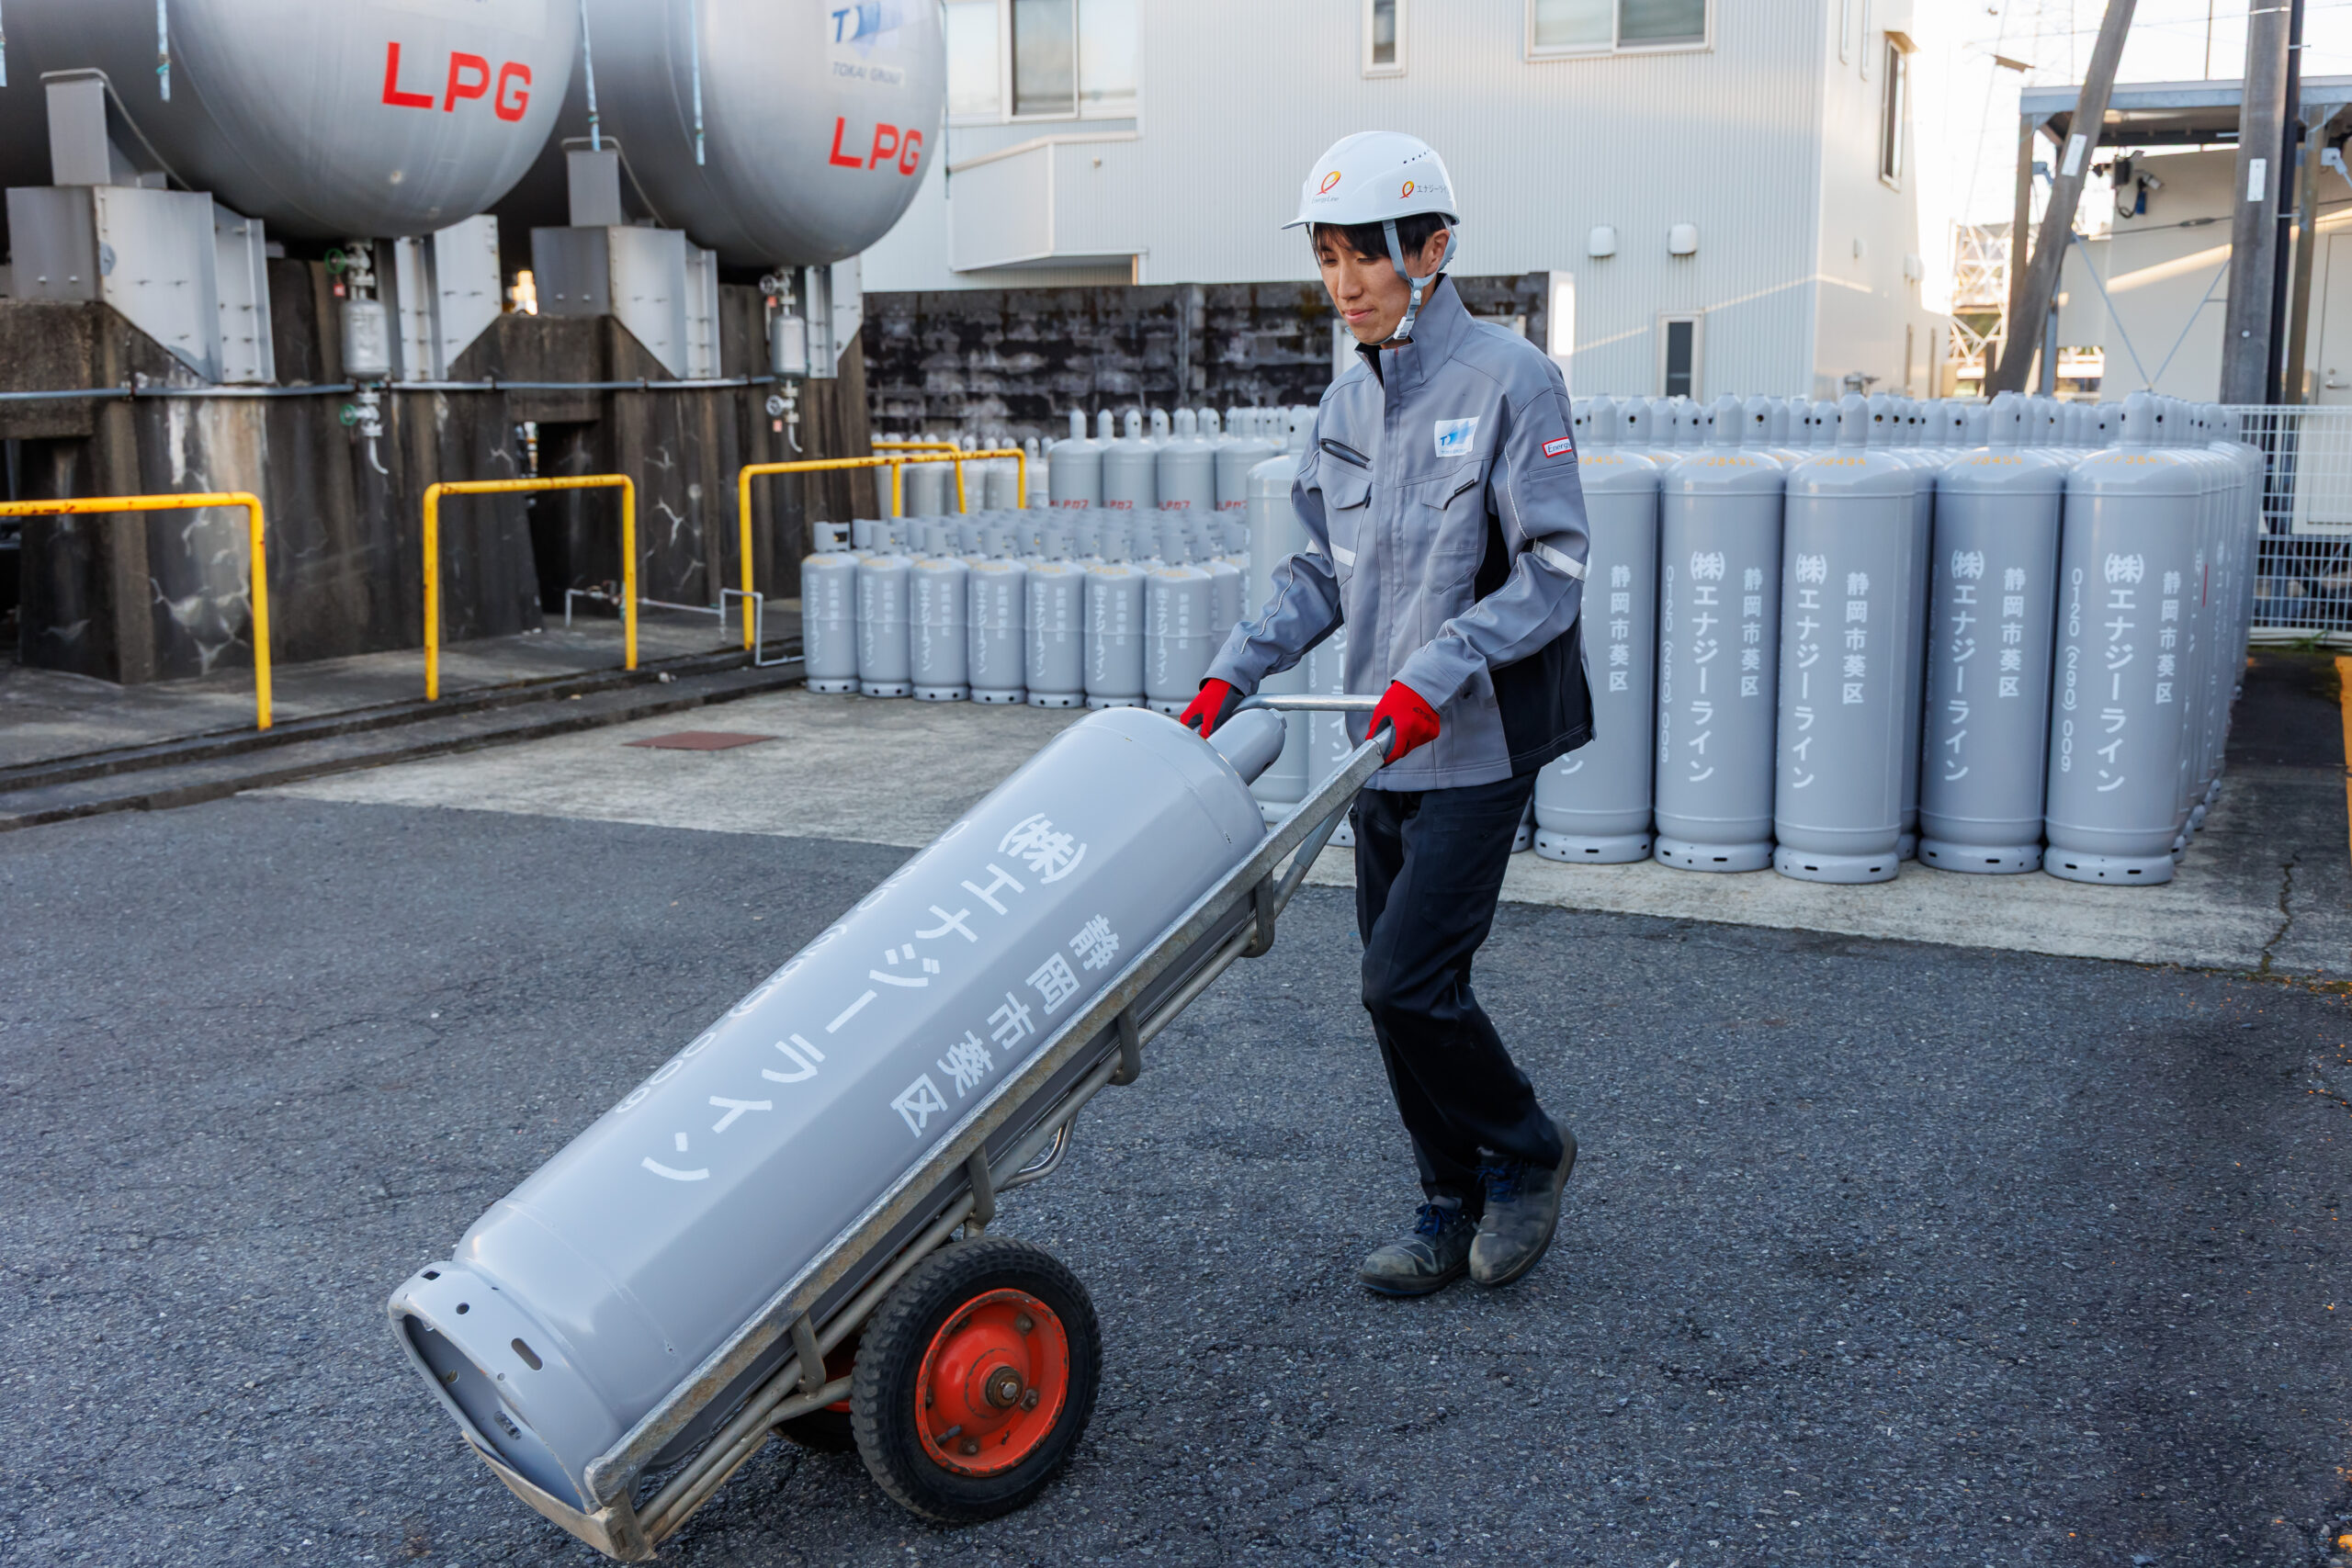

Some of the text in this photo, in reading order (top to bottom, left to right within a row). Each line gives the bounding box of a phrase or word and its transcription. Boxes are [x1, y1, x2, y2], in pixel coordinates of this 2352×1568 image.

[382, 41, 532, 122] LPG
[829, 116, 922, 176] LPG
[1609, 565, 1631, 693] 静岡市葵区
[1661, 565, 1675, 763] 0120 (290) 009
[1741, 568, 1763, 698] 静岡市葵区
[1842, 571, 1870, 705] 静岡市葵区
[1998, 568, 2026, 698] 静岡市葵区
[2061, 568, 2083, 773] 0120 (290) 009
[2155, 570, 2181, 705] 静岡市葵区
[641, 812, 1087, 1181] ㈱エナジーライン
[890, 914, 1122, 1138] 静岡市葵区
[616, 1032, 716, 1113] 009
